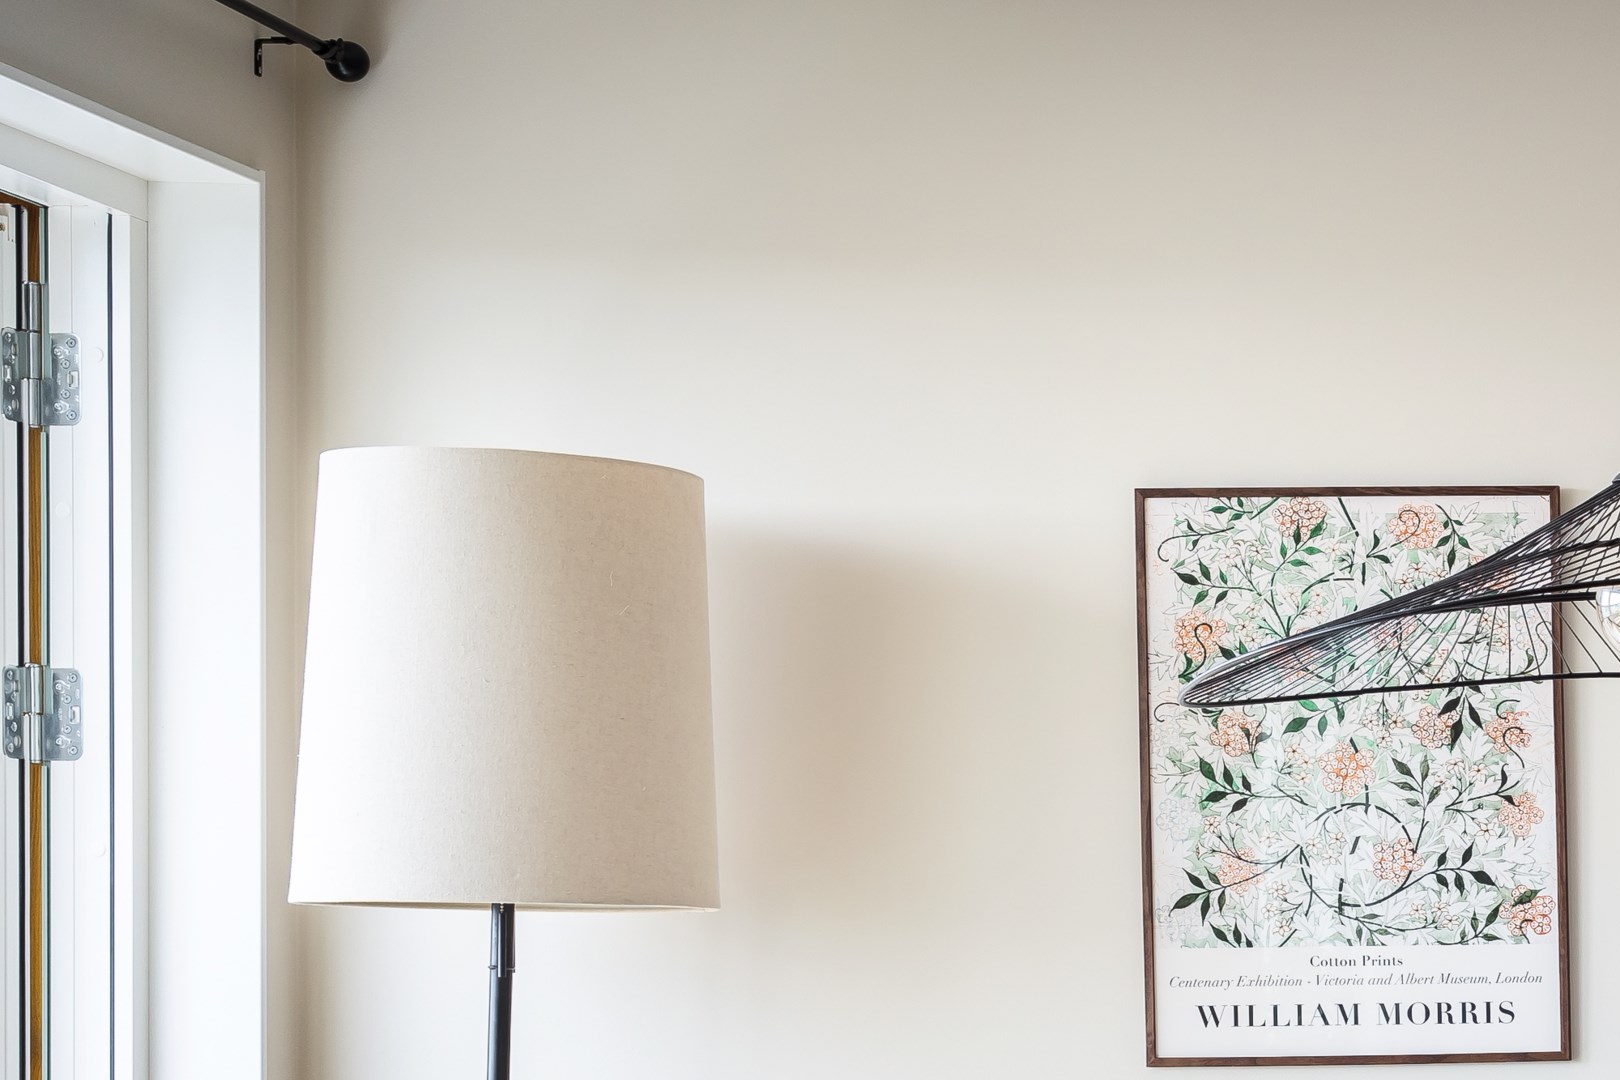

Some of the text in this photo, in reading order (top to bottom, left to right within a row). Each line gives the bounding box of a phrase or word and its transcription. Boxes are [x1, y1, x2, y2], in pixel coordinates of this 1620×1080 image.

[1310, 954, 1404, 967] Cotton Prints
[1169, 976, 1234, 991] Centenary
[1236, 974, 1303, 988] Exhibition
[1315, 973, 1364, 986] Victoria
[1367, 973, 1393, 986] and
[1395, 973, 1435, 985] Albert
[1437, 972, 1492, 985] Museum,
[1495, 971, 1543, 984] London
[1195, 1000, 1516, 1029] WILLIAM MORRIS
